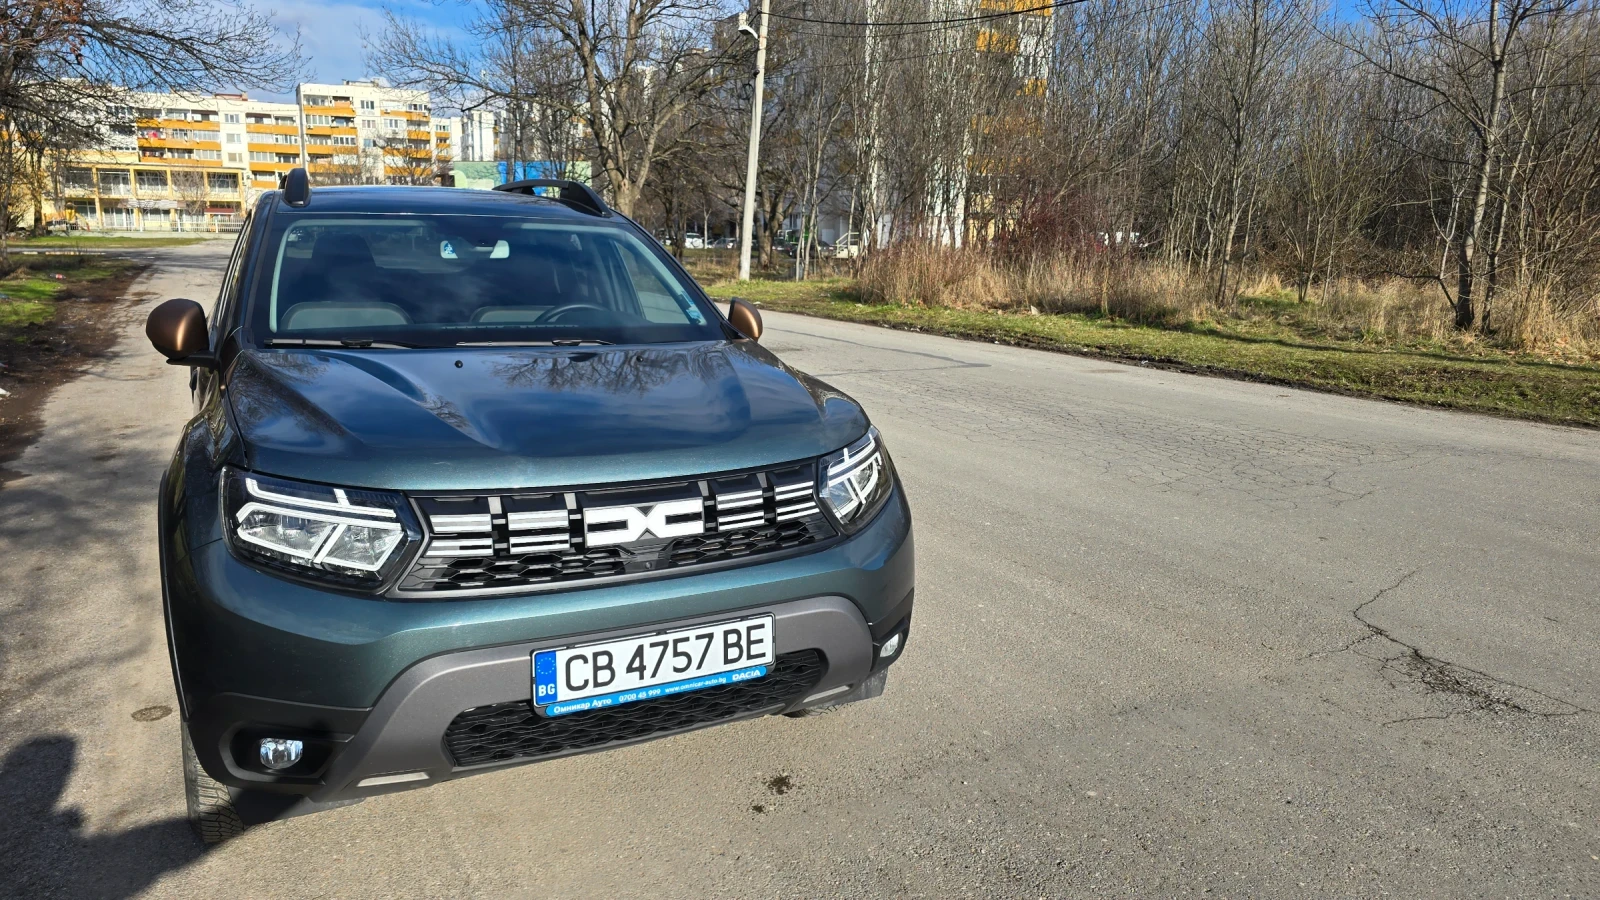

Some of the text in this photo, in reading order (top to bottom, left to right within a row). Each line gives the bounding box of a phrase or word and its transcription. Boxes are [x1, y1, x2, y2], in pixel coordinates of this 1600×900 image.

[565, 623, 766, 691] CB 4757 BE
[732, 669, 761, 681] DACIA
[538, 683, 556, 697] BG
[665, 676, 727, 694] www.omnicar-auto.bg
[553, 701, 591, 714] Омникар
[591, 697, 612, 708] Ауто
[618, 692, 637, 703] 0700
[648, 688, 661, 697] 999
